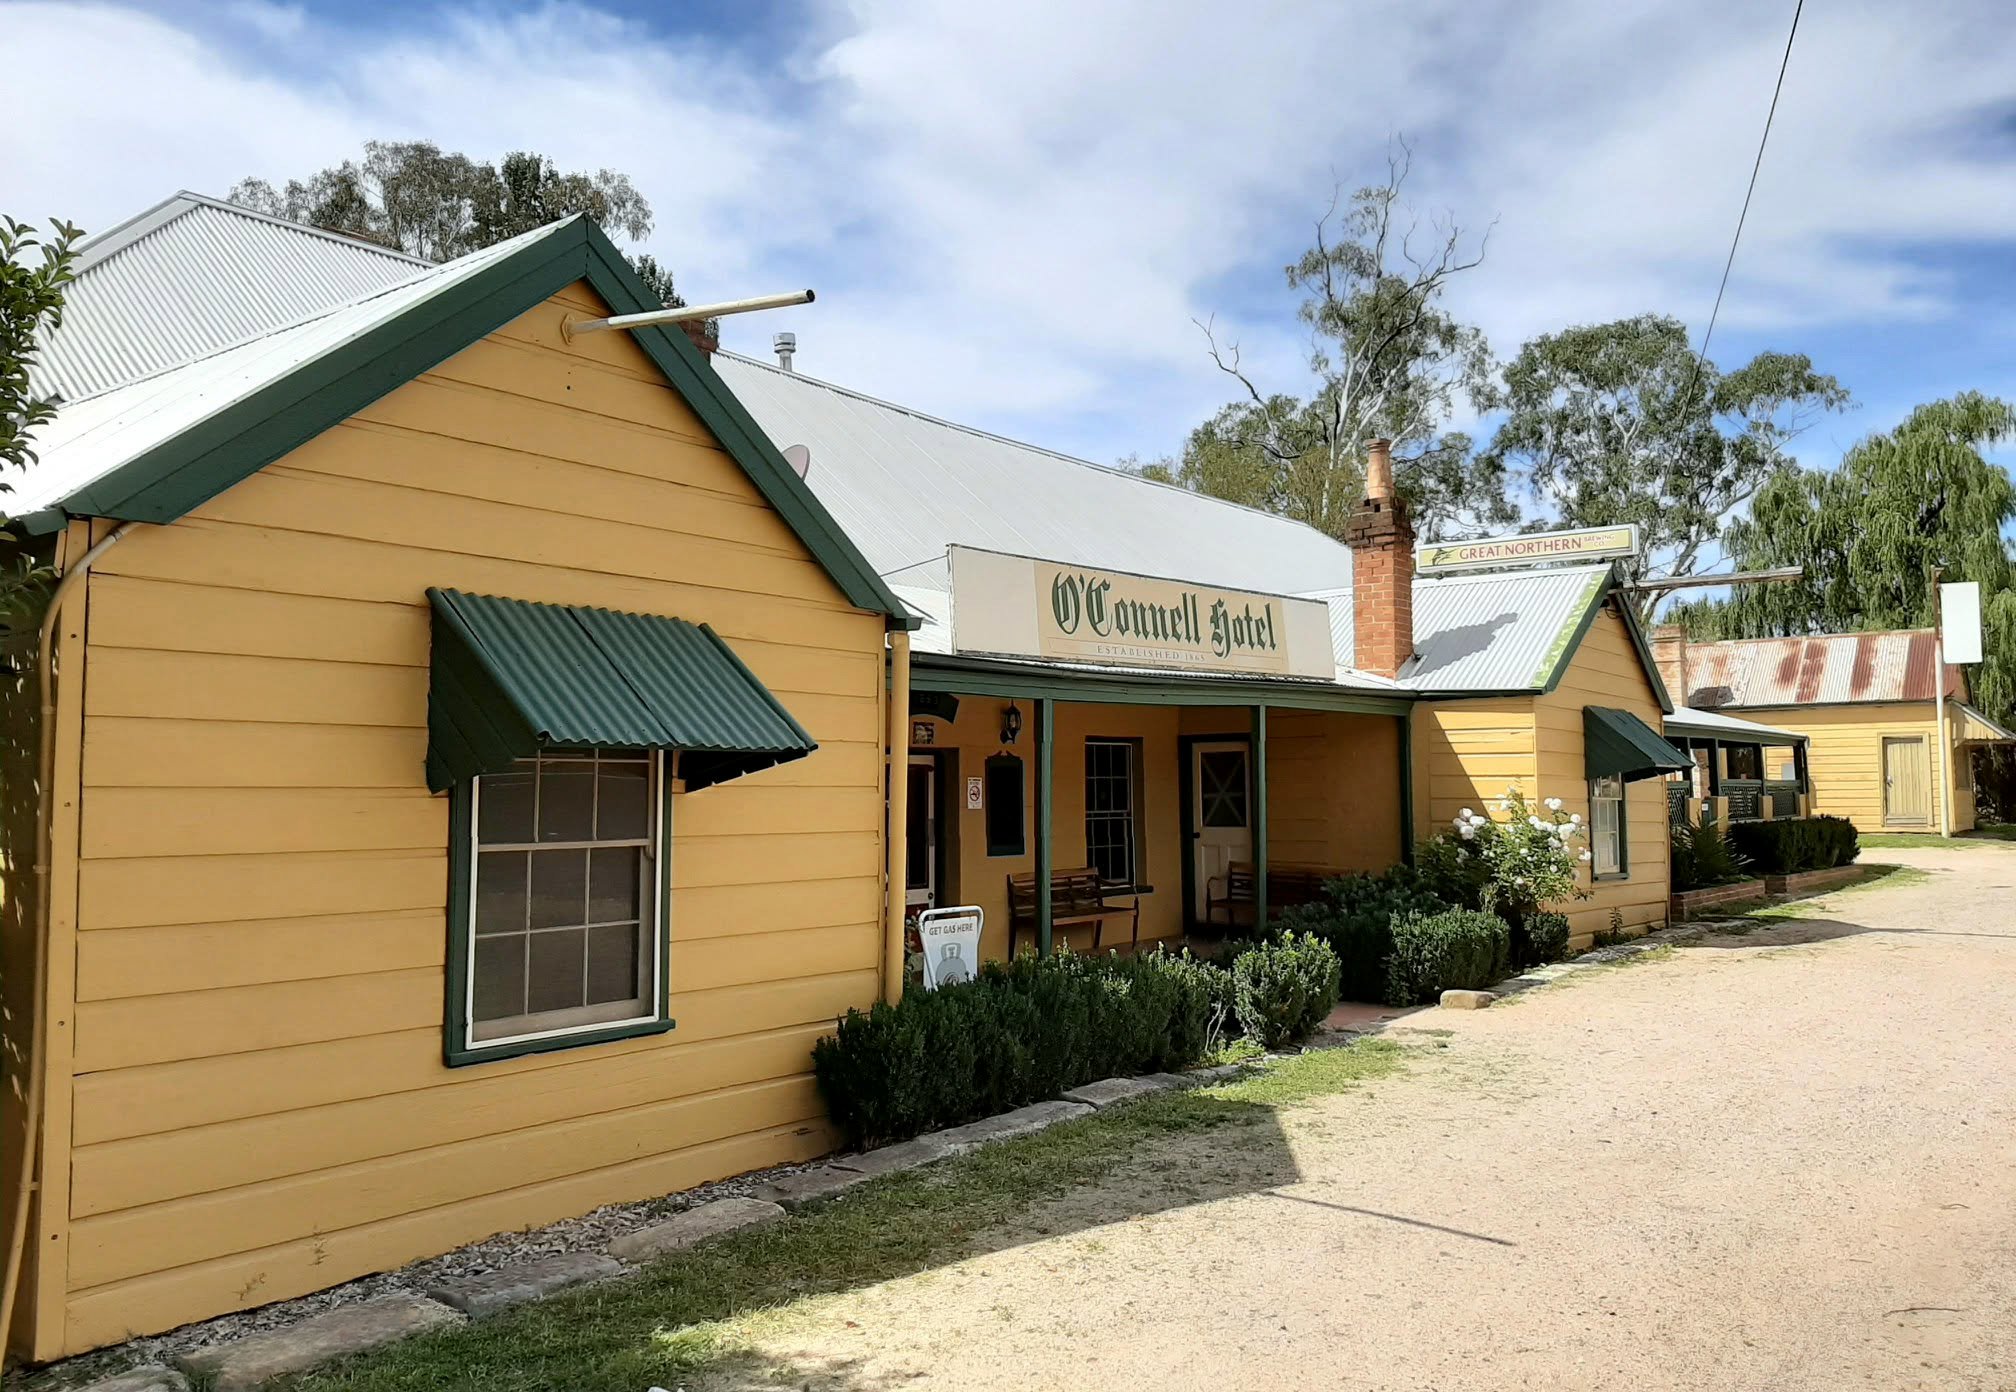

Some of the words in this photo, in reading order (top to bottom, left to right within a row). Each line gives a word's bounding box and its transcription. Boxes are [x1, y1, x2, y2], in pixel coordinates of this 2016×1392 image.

[1459, 544, 1501, 560] GREAT
[1505, 537, 1582, 556] NORTHERN
[1051, 571, 1201, 645] O'Connell
[1209, 598, 1277, 659] Hotel
[1097, 645, 1180, 660] ESTABLISHED
[929, 927, 942, 936] GET
[943, 925, 956, 934] GAS
[957, 923, 973, 933] HERE
